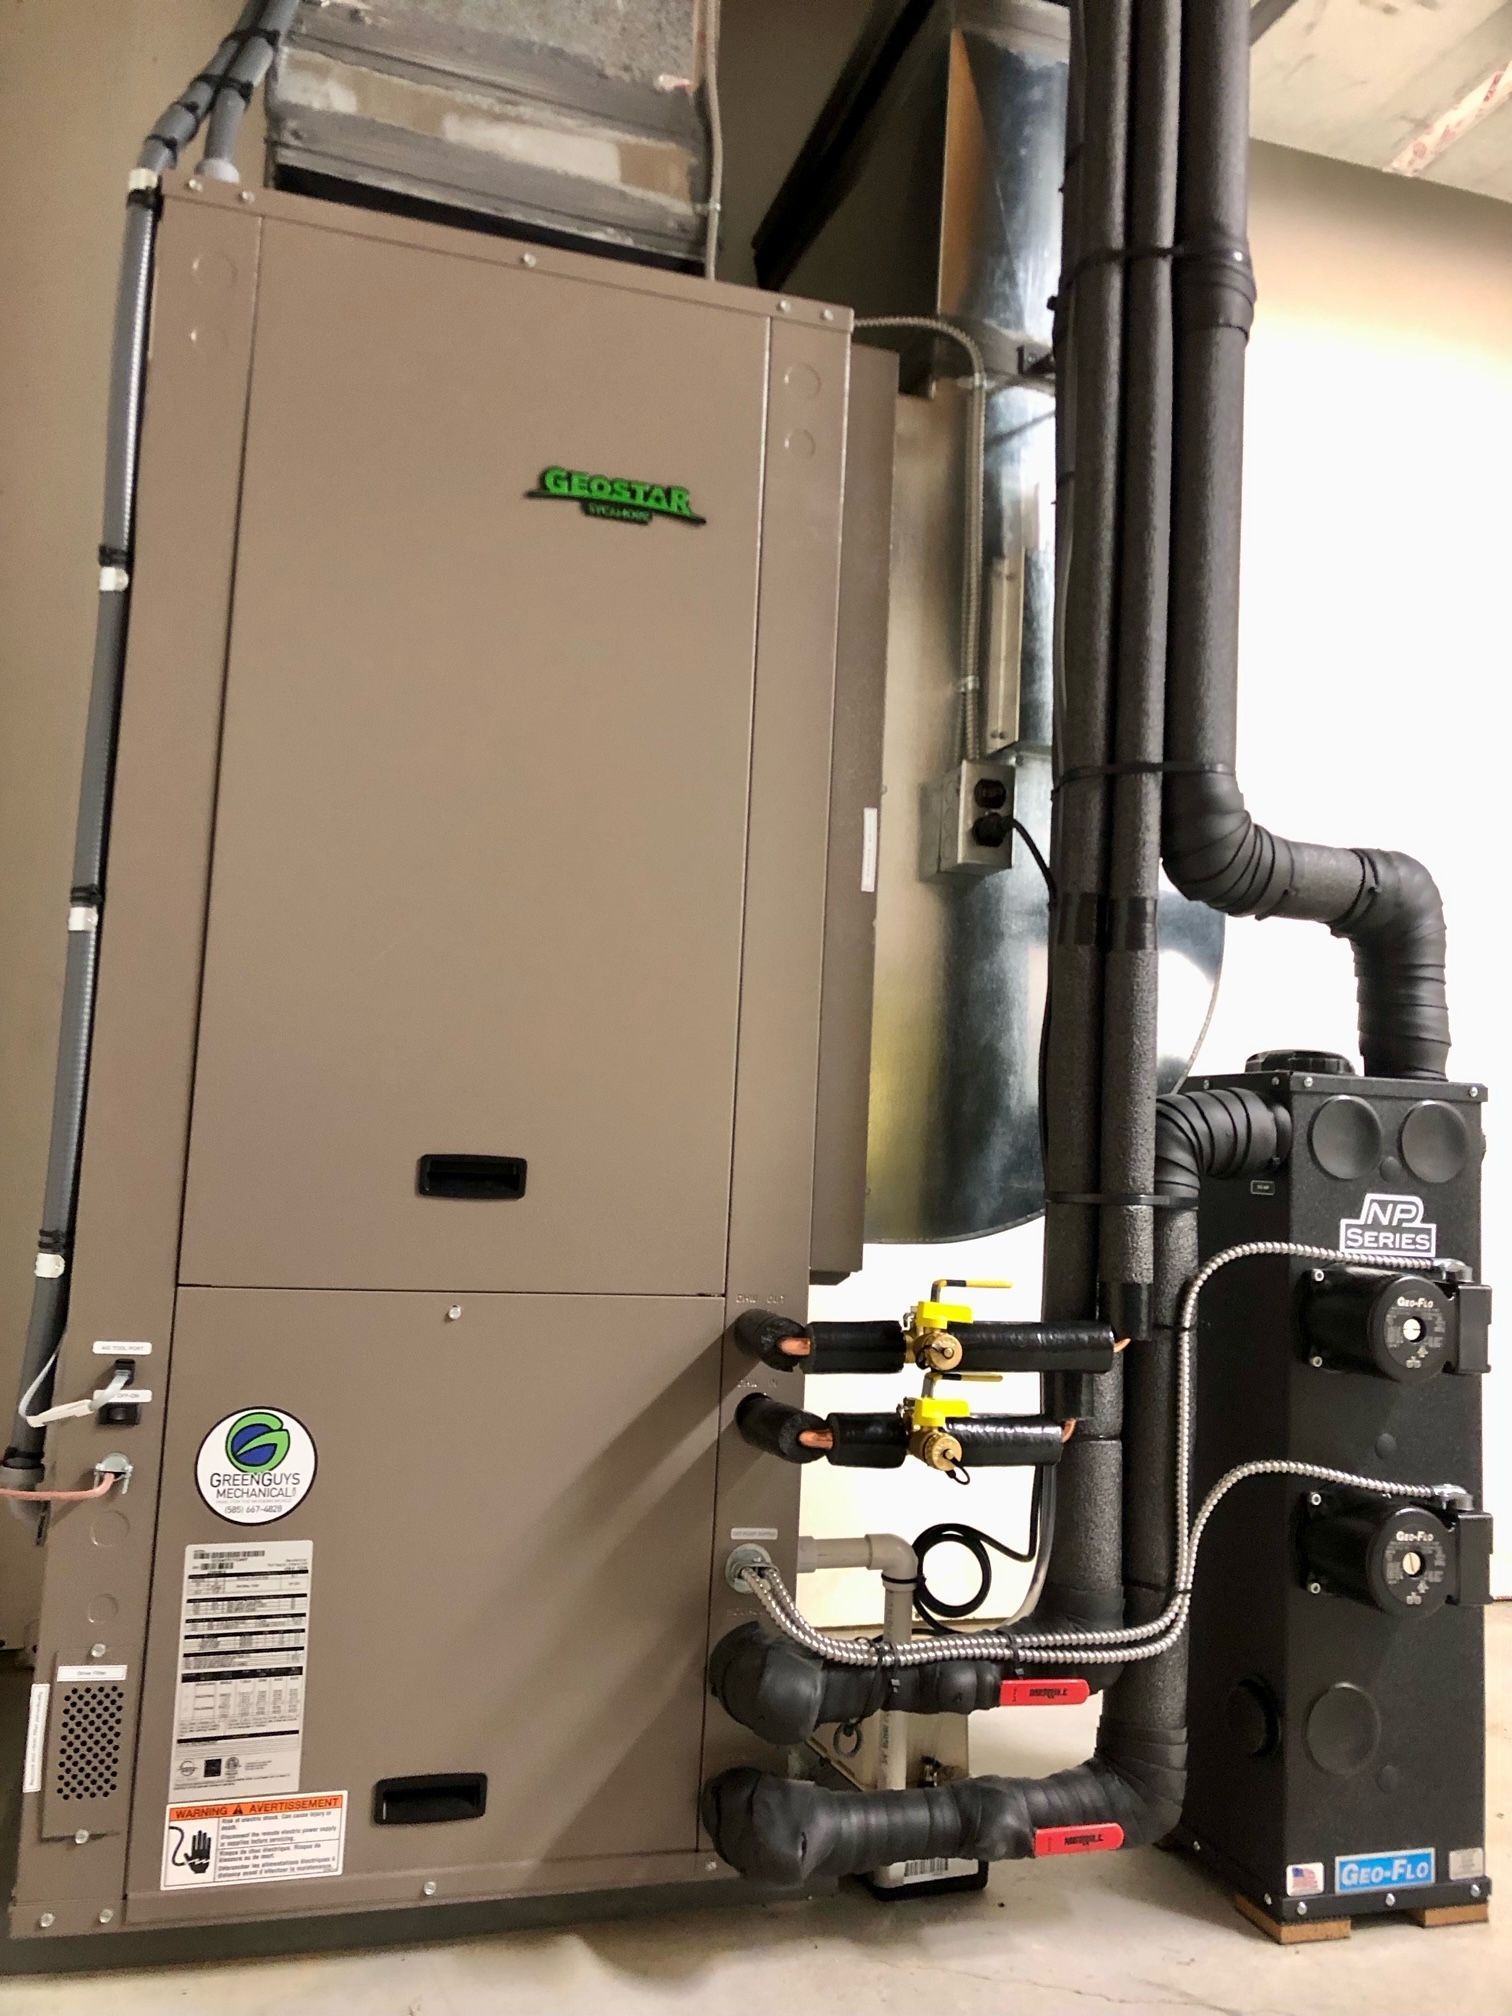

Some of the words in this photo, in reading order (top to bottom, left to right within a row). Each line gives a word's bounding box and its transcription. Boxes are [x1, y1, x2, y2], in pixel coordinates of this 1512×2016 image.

[545, 467, 692, 517] GEOSTAR
[1366, 1202, 1418, 1226] NP
[1346, 1228, 1430, 1250] SERIES
[209, 1472, 301, 1488] GREENGUYS
[216, 1487, 293, 1499] MECHANICAL
[176, 1806, 228, 1819] WARNING
[250, 1797, 339, 1814] AVERTISSEMENT
[1342, 1859, 1428, 1886] GEO-FLO
